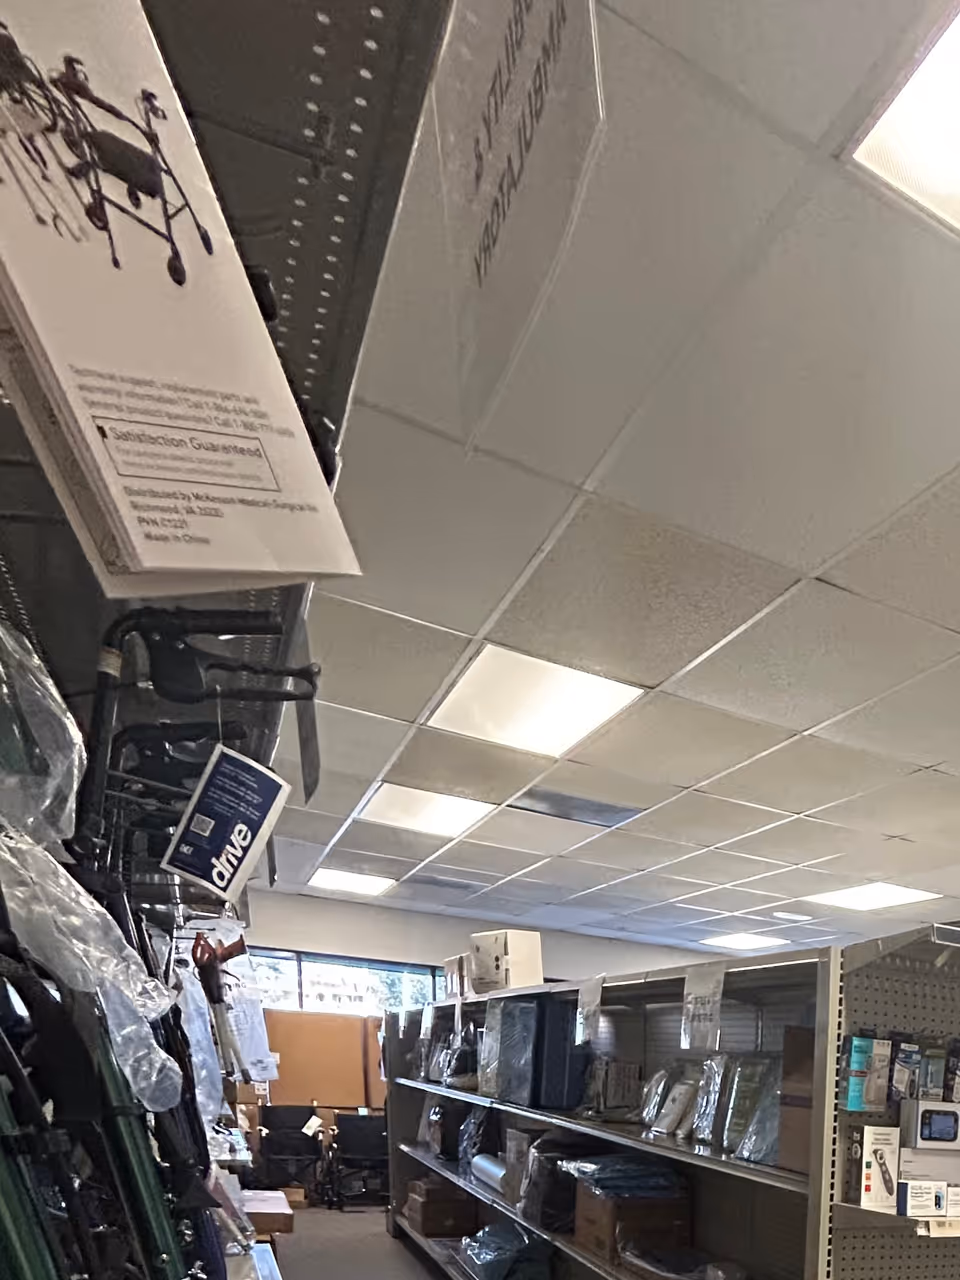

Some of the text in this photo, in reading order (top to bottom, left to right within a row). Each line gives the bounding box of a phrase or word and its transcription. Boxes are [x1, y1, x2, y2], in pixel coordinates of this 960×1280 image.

[109, 425, 188, 449] Satisfaction
[189, 436, 262, 458] Guaranteed
[211, 823, 252, 888] drive
